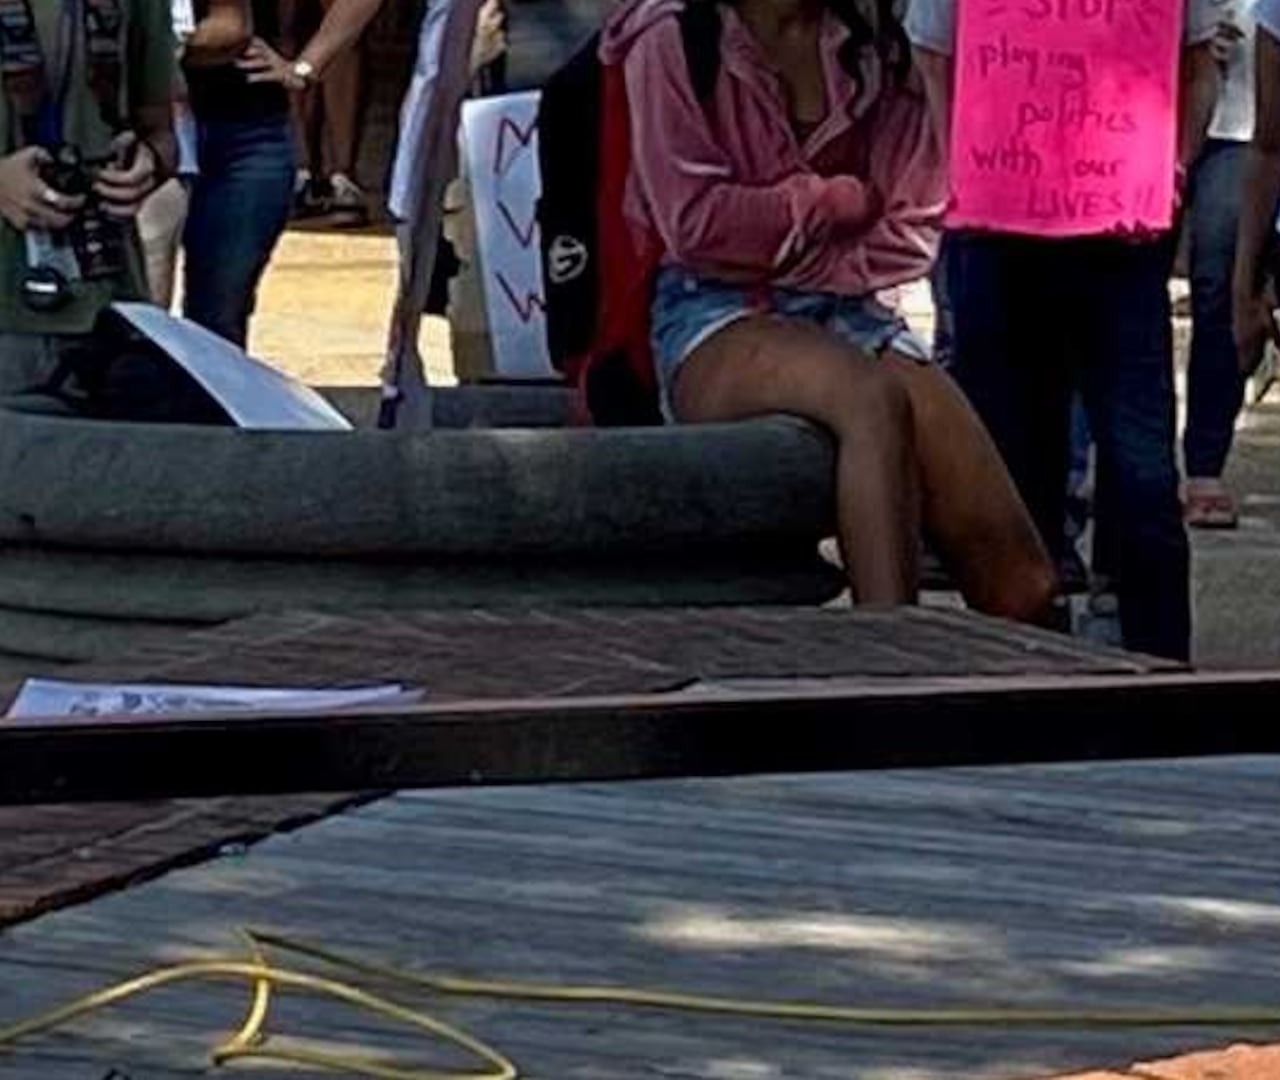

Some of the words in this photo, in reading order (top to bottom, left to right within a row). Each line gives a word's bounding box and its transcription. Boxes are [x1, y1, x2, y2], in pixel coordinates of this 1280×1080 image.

[978, 36, 1087, 89] playing
[1019, 87, 1138, 133] politics
[970, 136, 1042, 177] with
[1074, 159, 1126, 179] our
